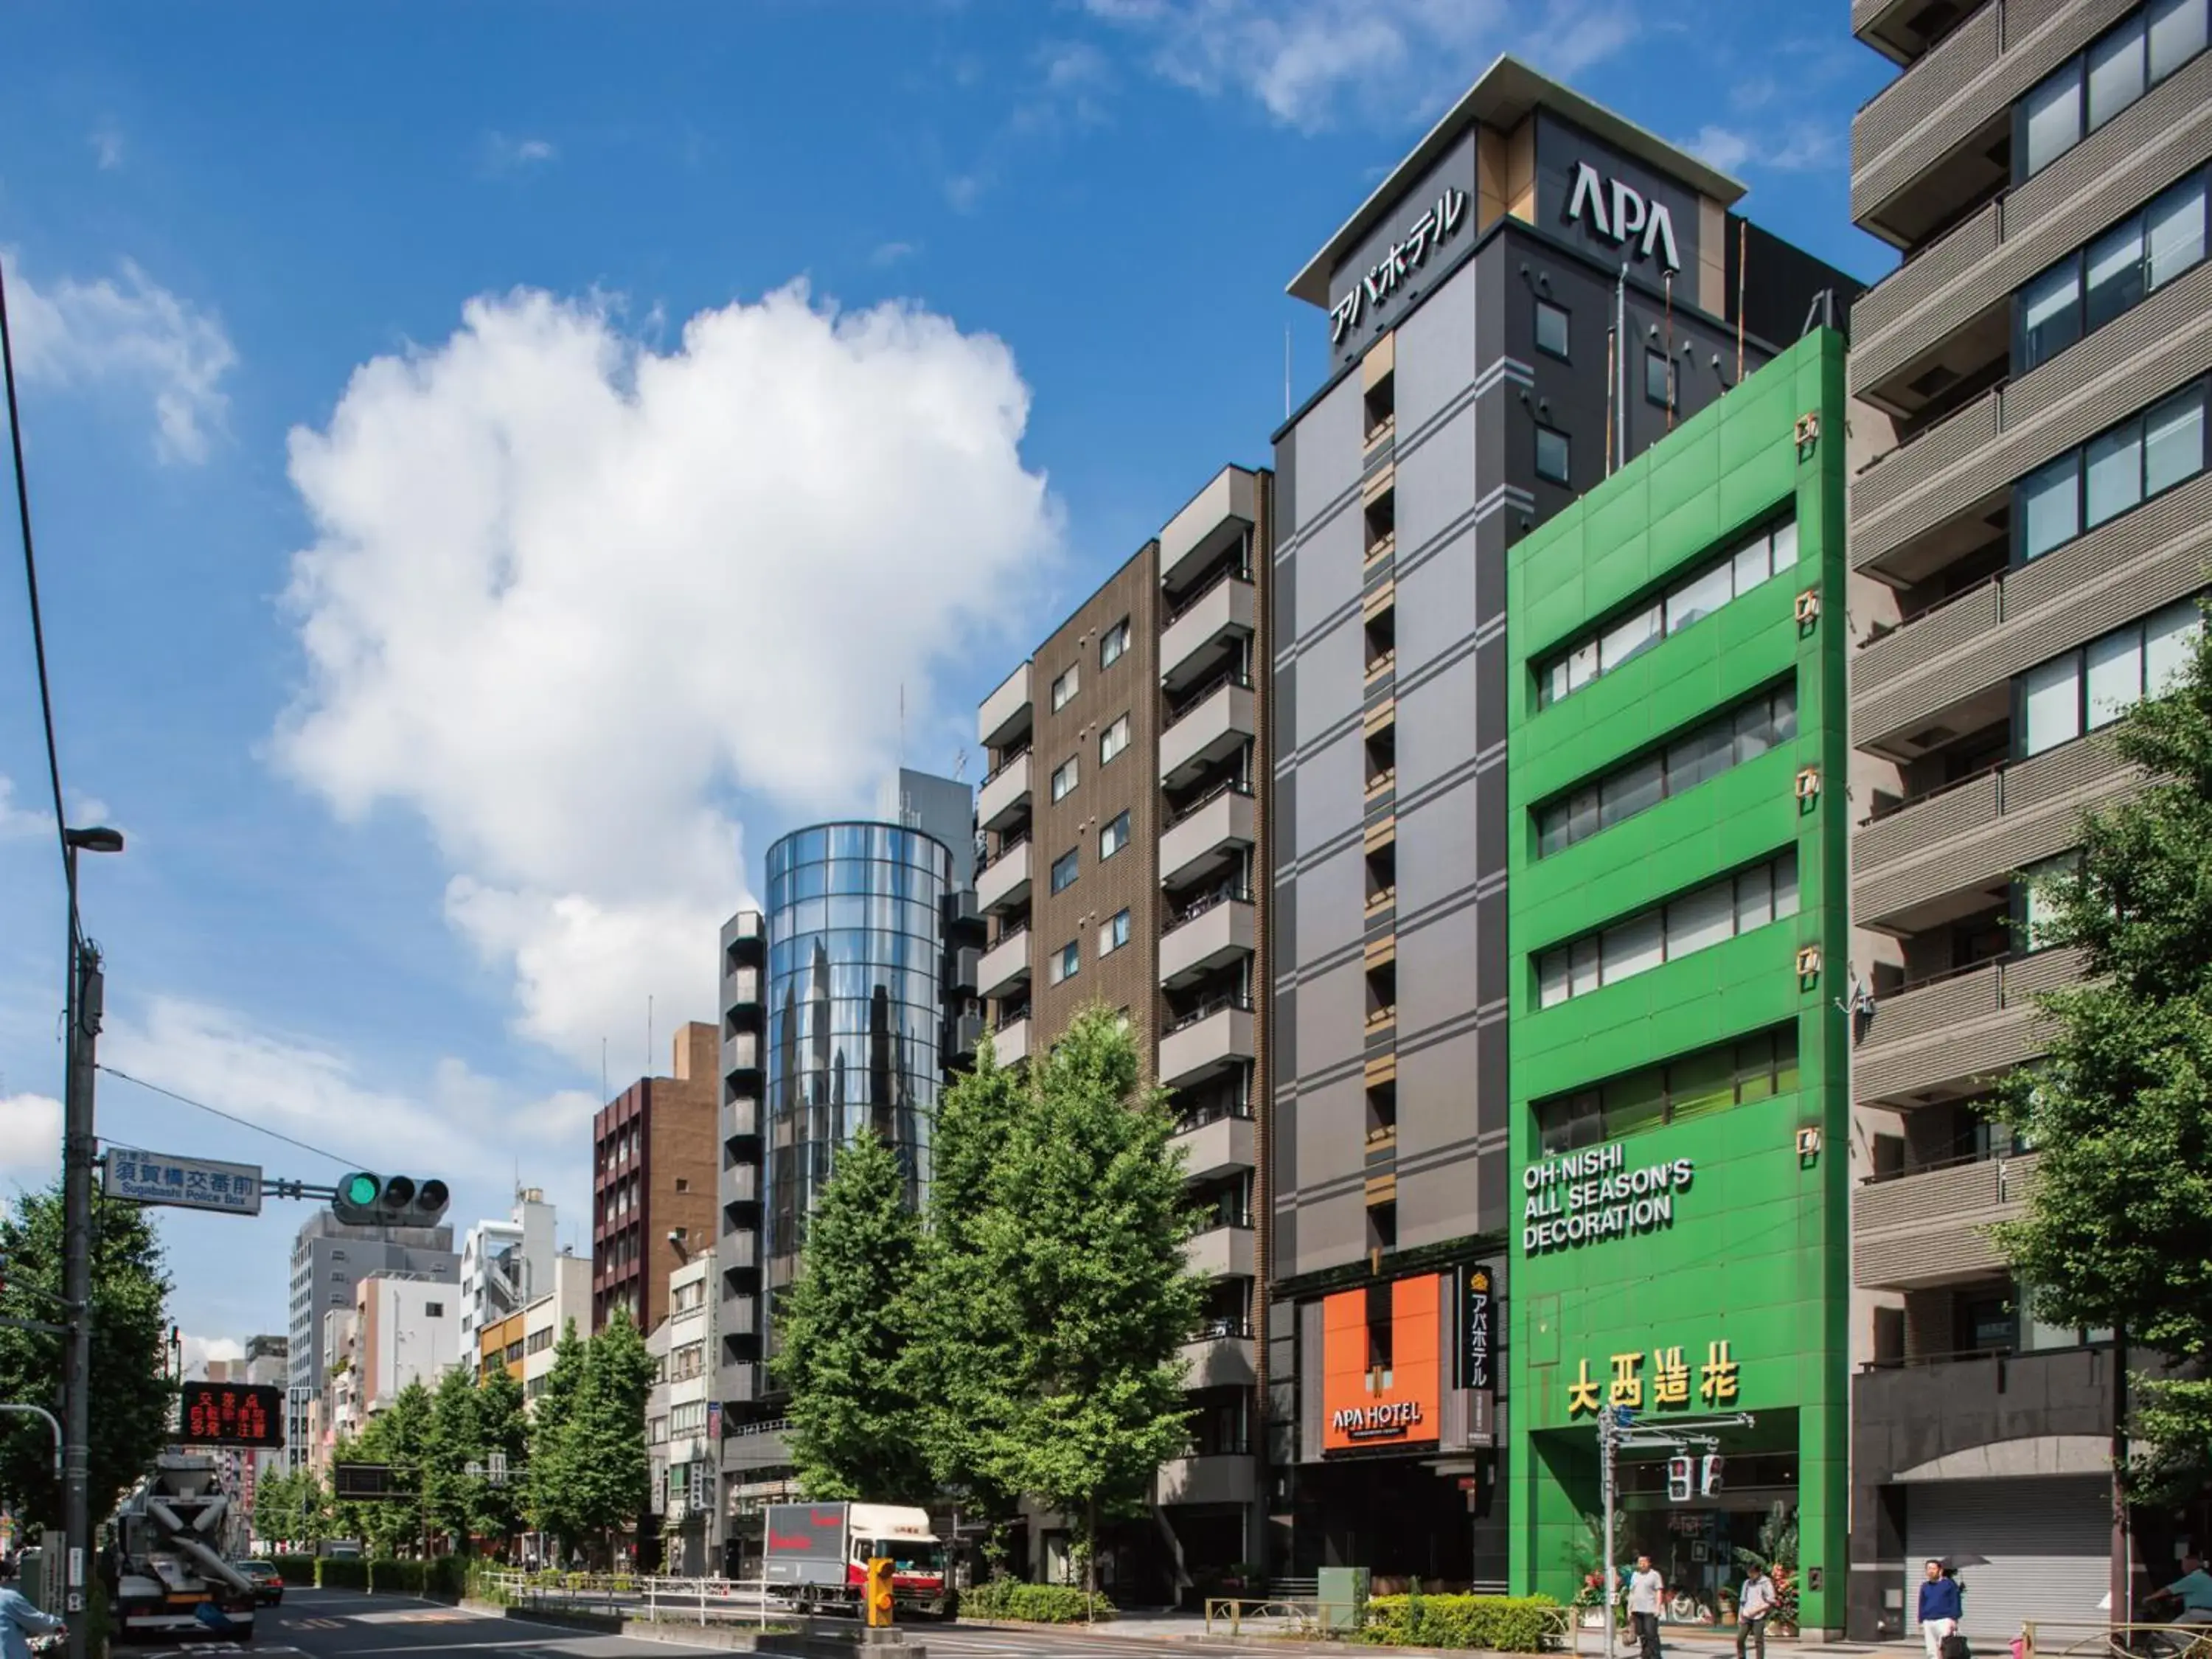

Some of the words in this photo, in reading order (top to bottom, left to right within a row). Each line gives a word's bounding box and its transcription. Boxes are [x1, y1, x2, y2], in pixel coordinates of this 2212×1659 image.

[1568, 160, 1680, 271] APA
[1330, 187, 1464, 343] アパホテル
[115, 1161, 253, 1195] 須賀橋交番前
[122, 1181, 181, 1198] Sugabashi
[186, 1189, 220, 1203] Police
[224, 1193, 246, 1206] Box
[1524, 1191, 1562, 1220] ALL
[1568, 1158, 1692, 1210] SEASON'S
[1523, 1194, 1672, 1250] DECORATION
[1472, 1293, 1487, 1386] アパホテル
[1568, 1339, 1739, 1413] 大西造花
[1332, 1408, 1363, 1428] APA
[1368, 1402, 1420, 1426] HOTEL
